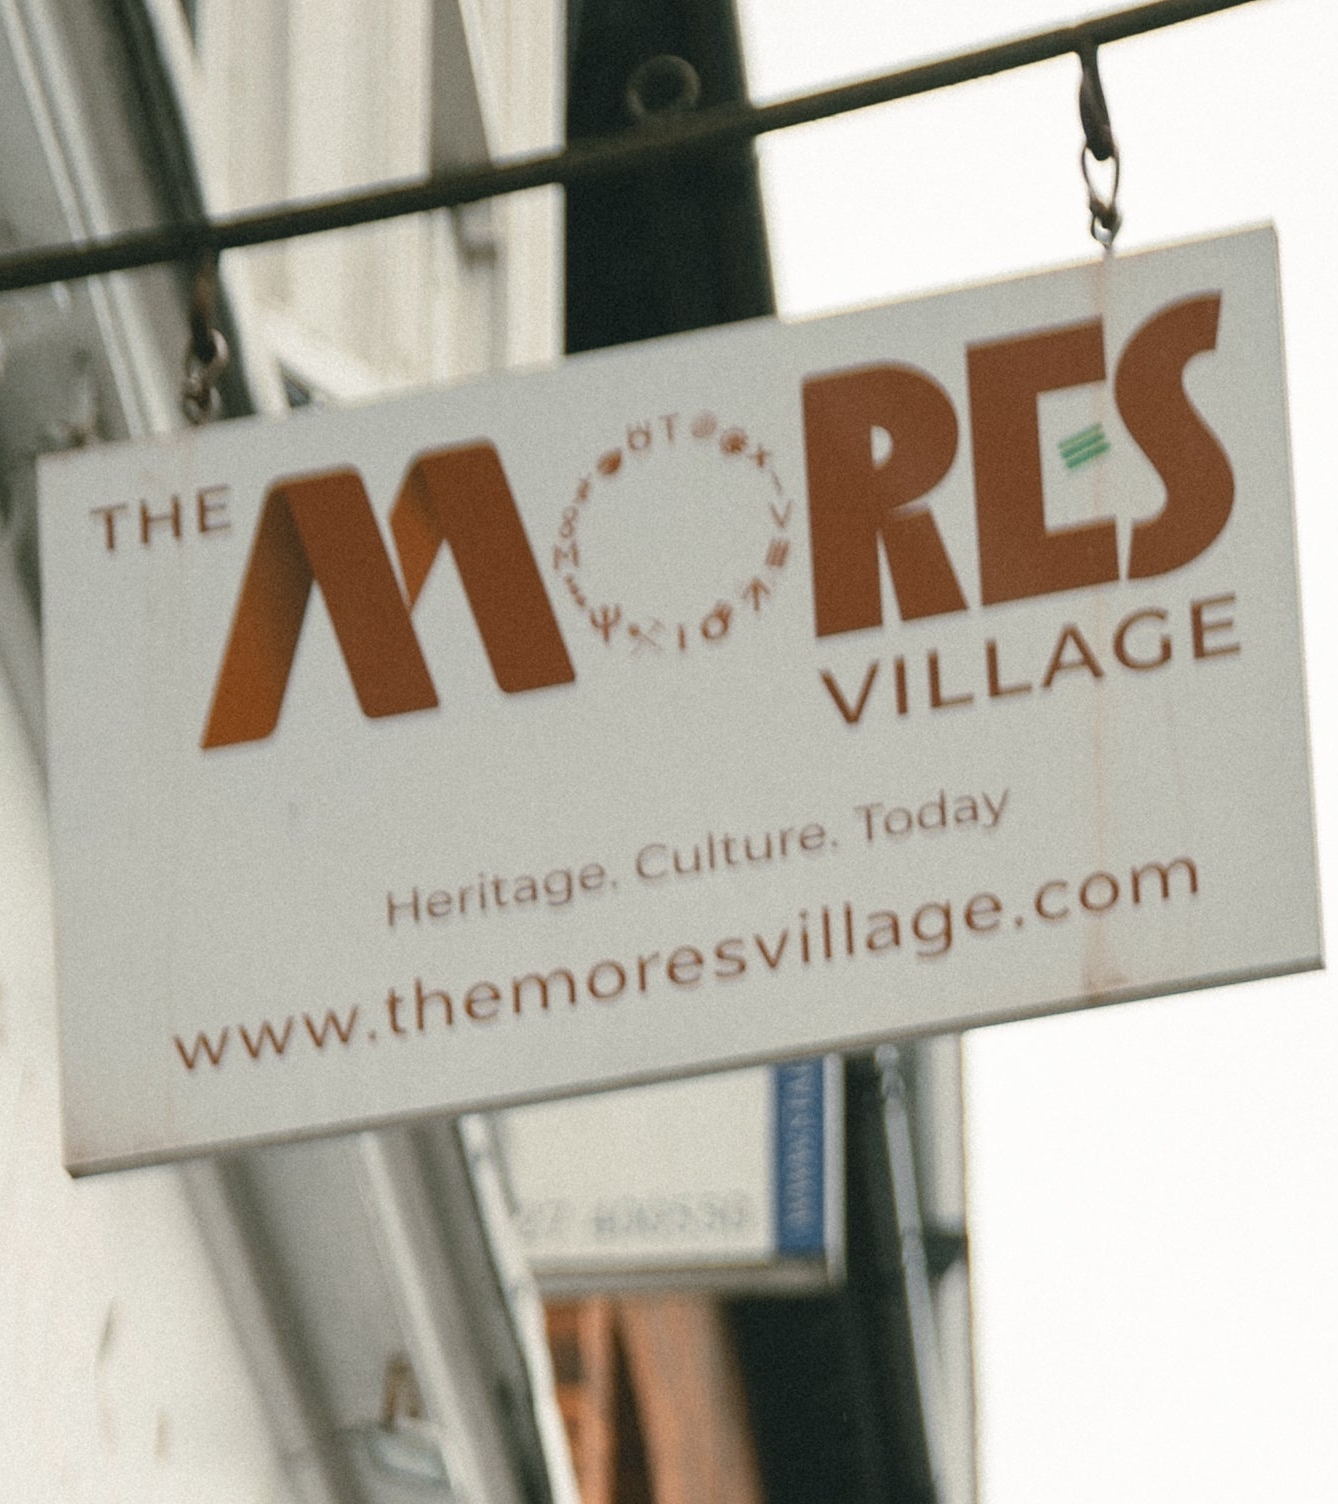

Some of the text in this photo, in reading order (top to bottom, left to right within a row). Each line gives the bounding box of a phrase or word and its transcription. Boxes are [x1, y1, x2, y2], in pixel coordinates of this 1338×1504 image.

[90, 484, 231, 552] THE
[819, 593, 1242, 726] VILLAGE
[385, 787, 1011, 926] Heritage. Culture. Today
[173, 852, 1201, 1072] www.themoresvillage.com
